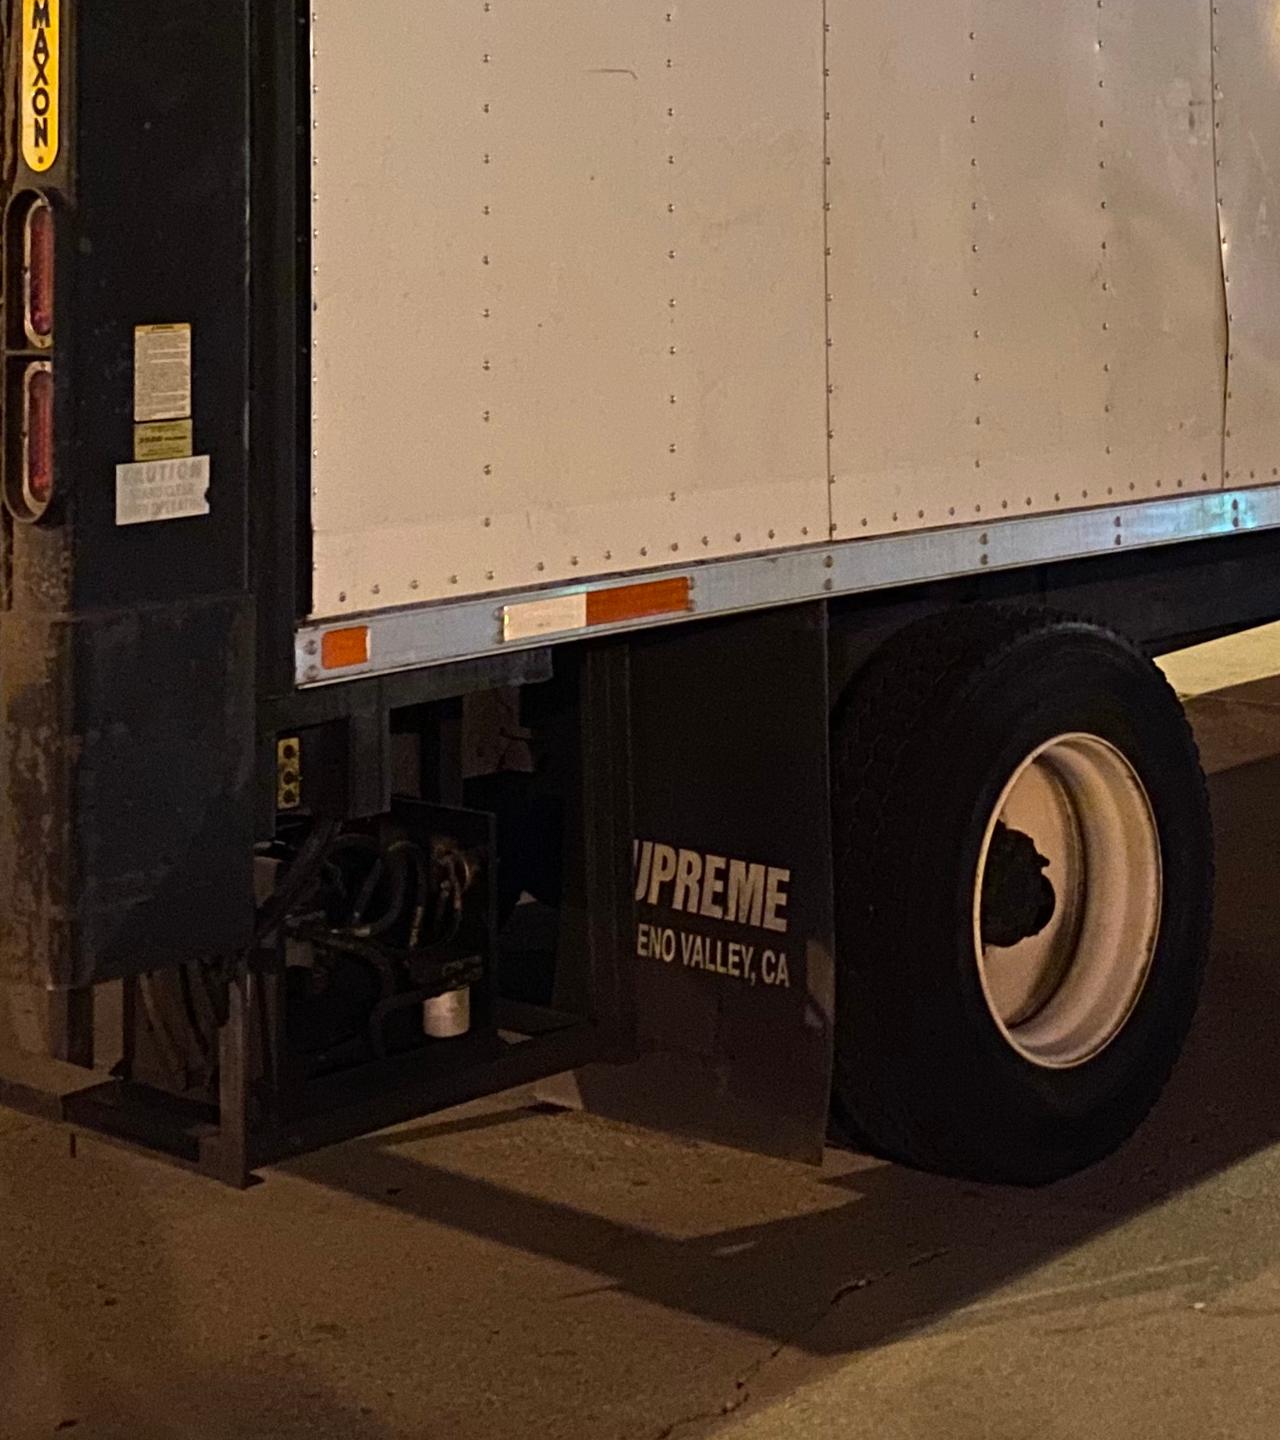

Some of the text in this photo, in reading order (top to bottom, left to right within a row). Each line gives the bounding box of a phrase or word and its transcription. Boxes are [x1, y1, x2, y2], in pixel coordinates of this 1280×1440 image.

[32, 0, 51, 148] MAXON
[636, 923, 791, 988] ENO VALLEY, CA
